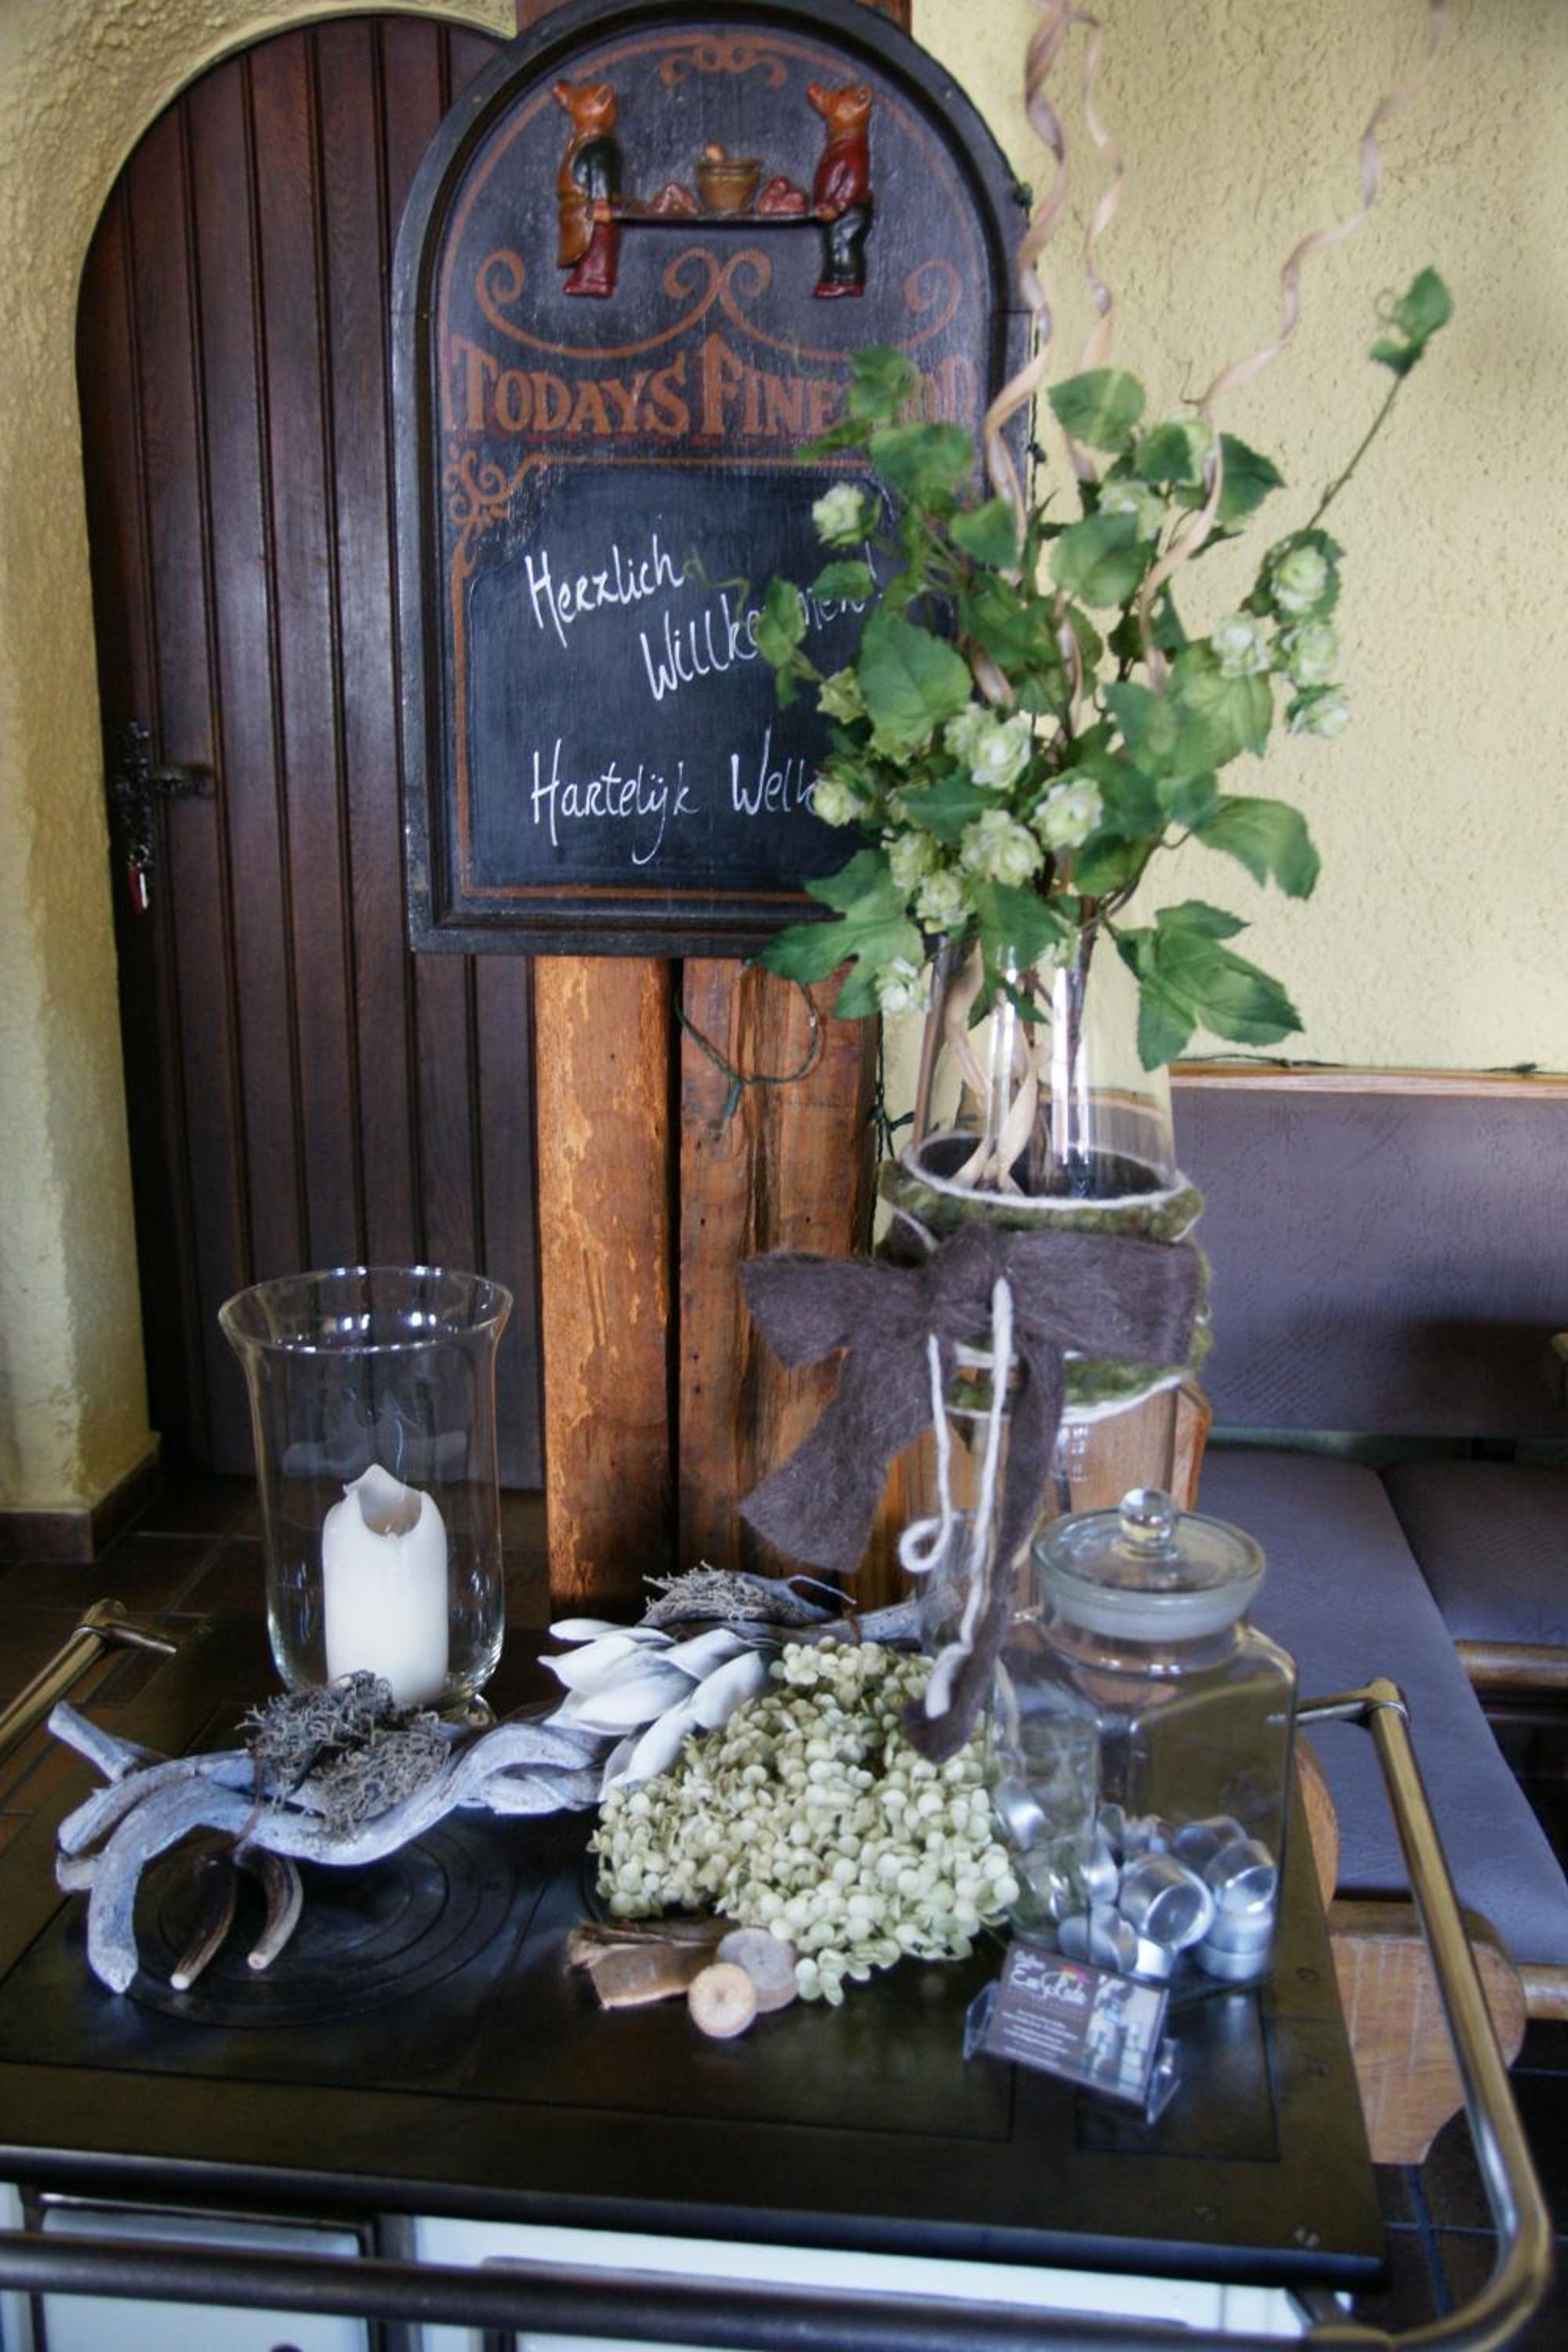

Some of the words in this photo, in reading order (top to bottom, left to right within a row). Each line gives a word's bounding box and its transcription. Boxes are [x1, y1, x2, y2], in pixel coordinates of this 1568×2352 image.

[450, 332, 691, 437] TODAYS
[700, 331, 851, 436] FINE
[524, 532, 684, 648] Herzlich
[530, 738, 700, 865] Hartelijk
